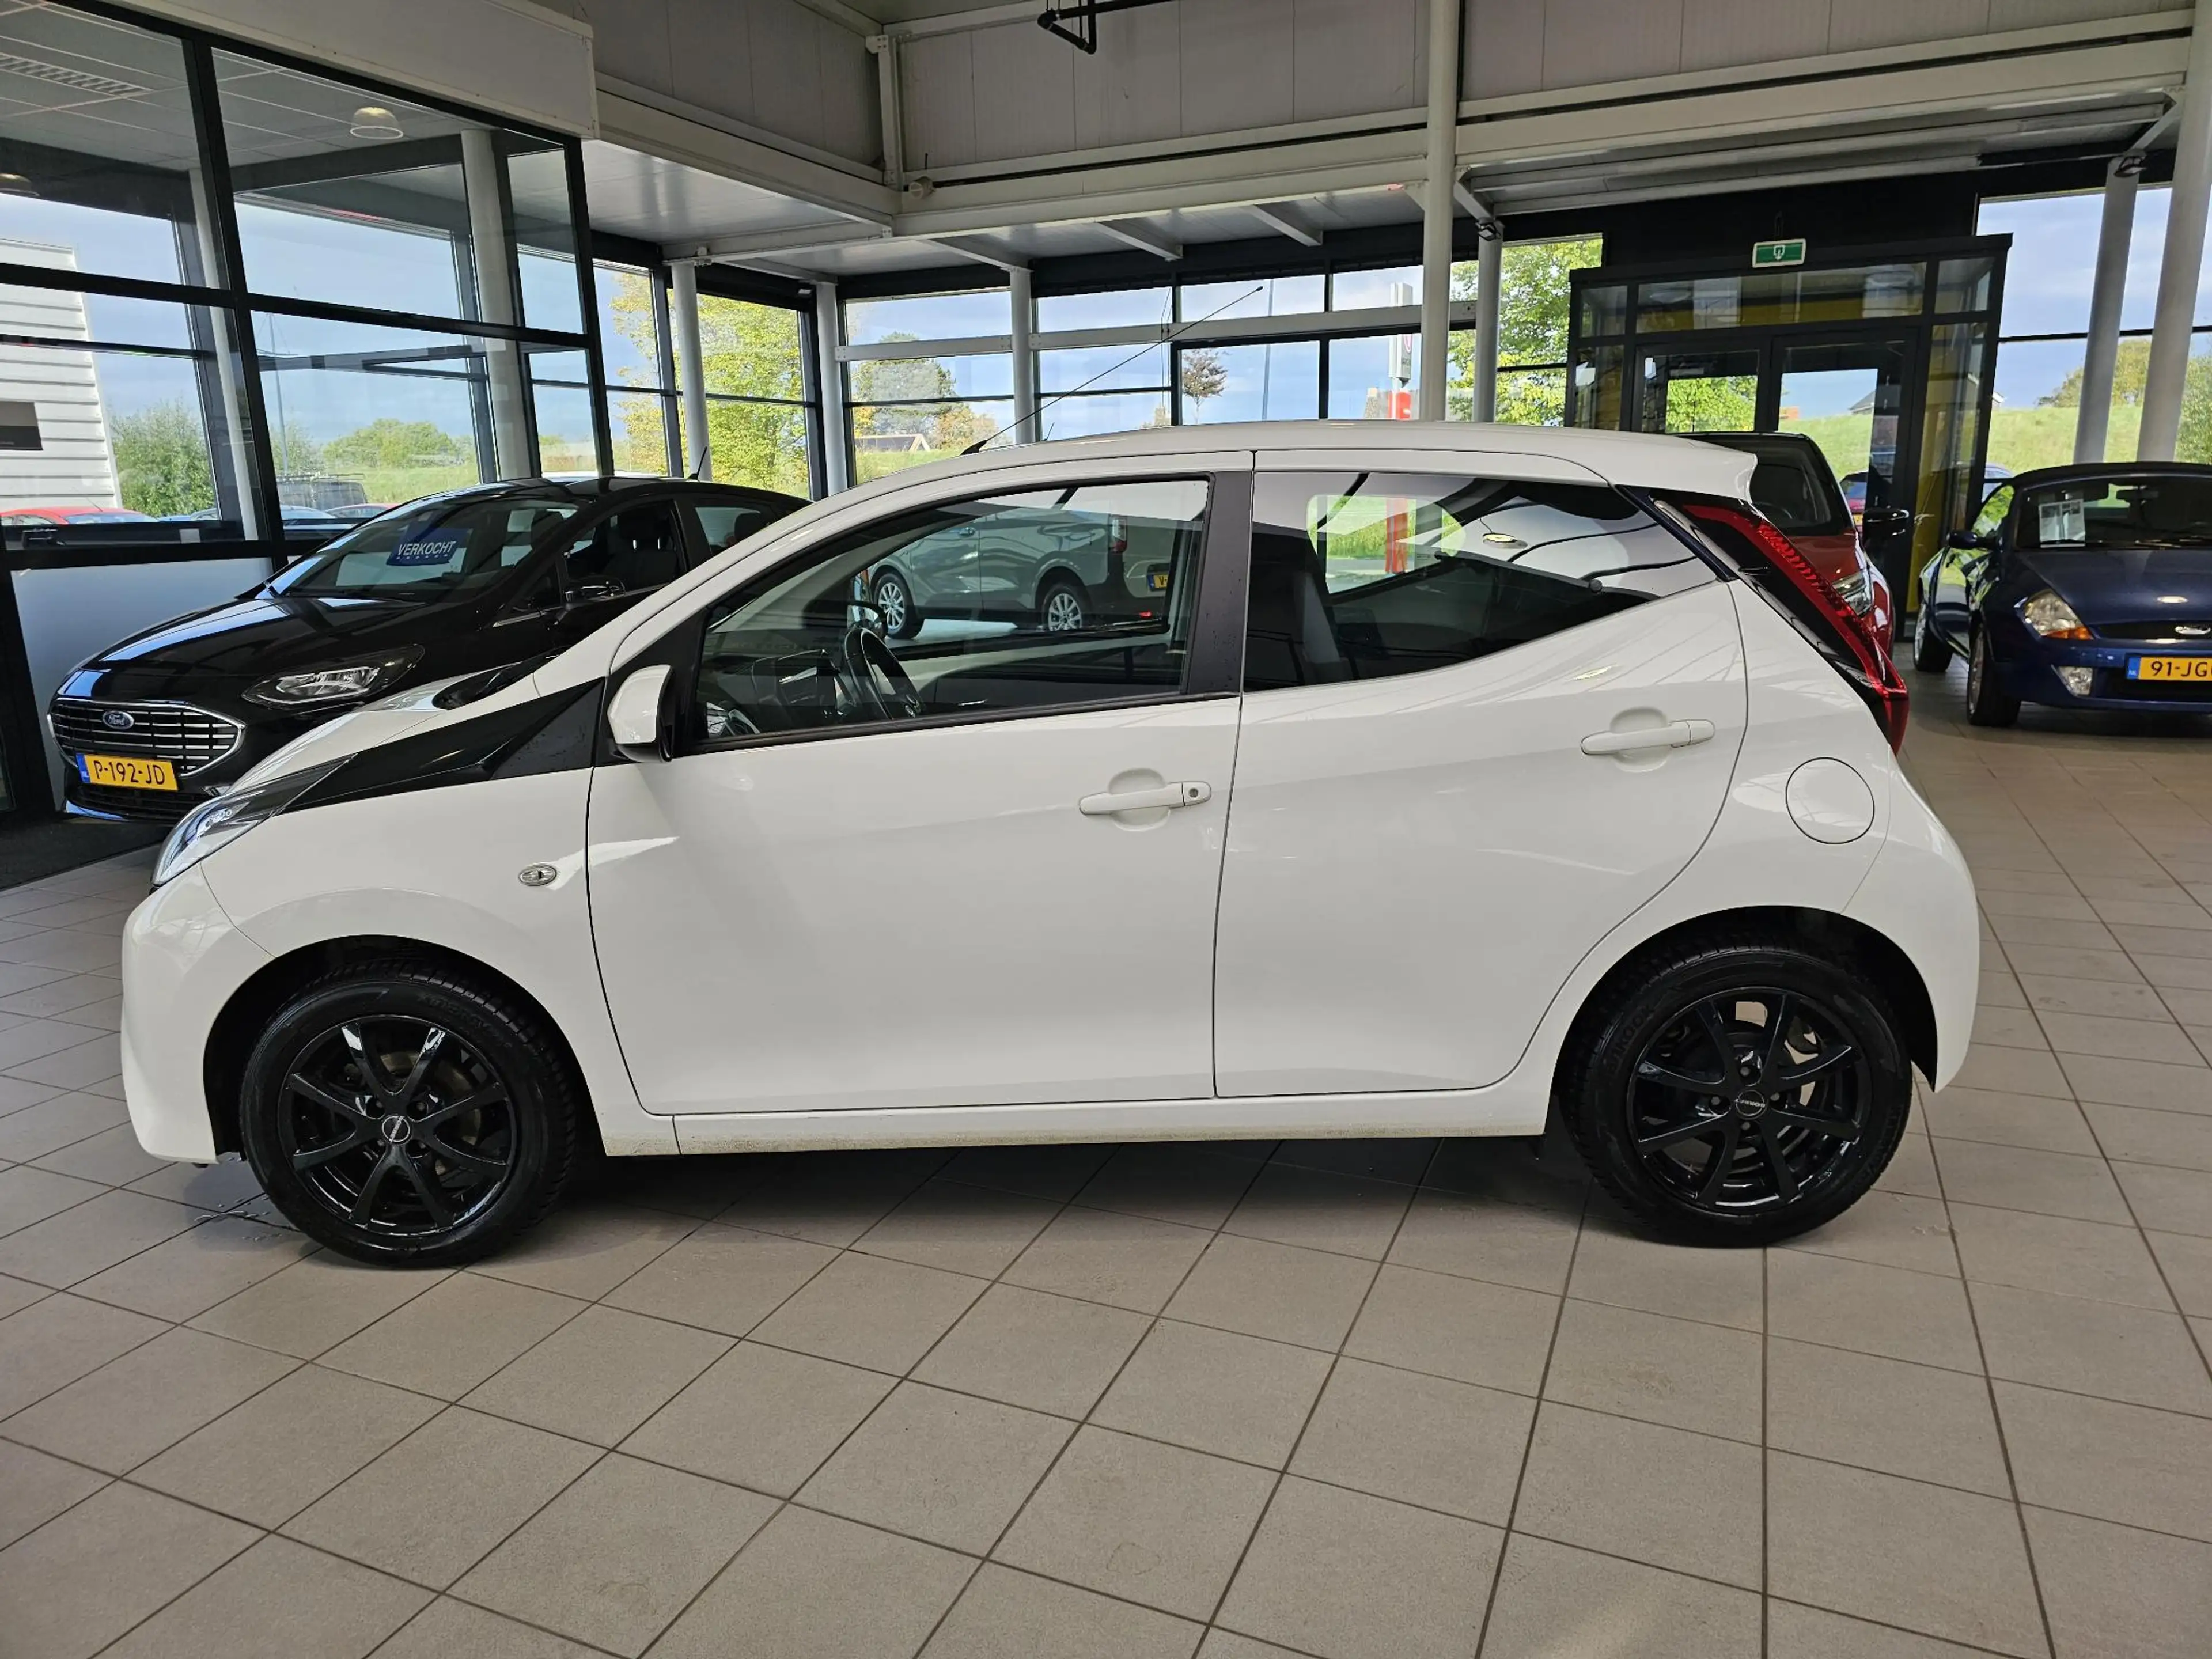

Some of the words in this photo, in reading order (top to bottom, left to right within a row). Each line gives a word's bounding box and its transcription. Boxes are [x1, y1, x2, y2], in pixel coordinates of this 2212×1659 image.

[397, 541, 457, 556] VERKOCHT
[2150, 661, 2212, 677] 91-JG
[93, 760, 165, 785] P-192-JD
